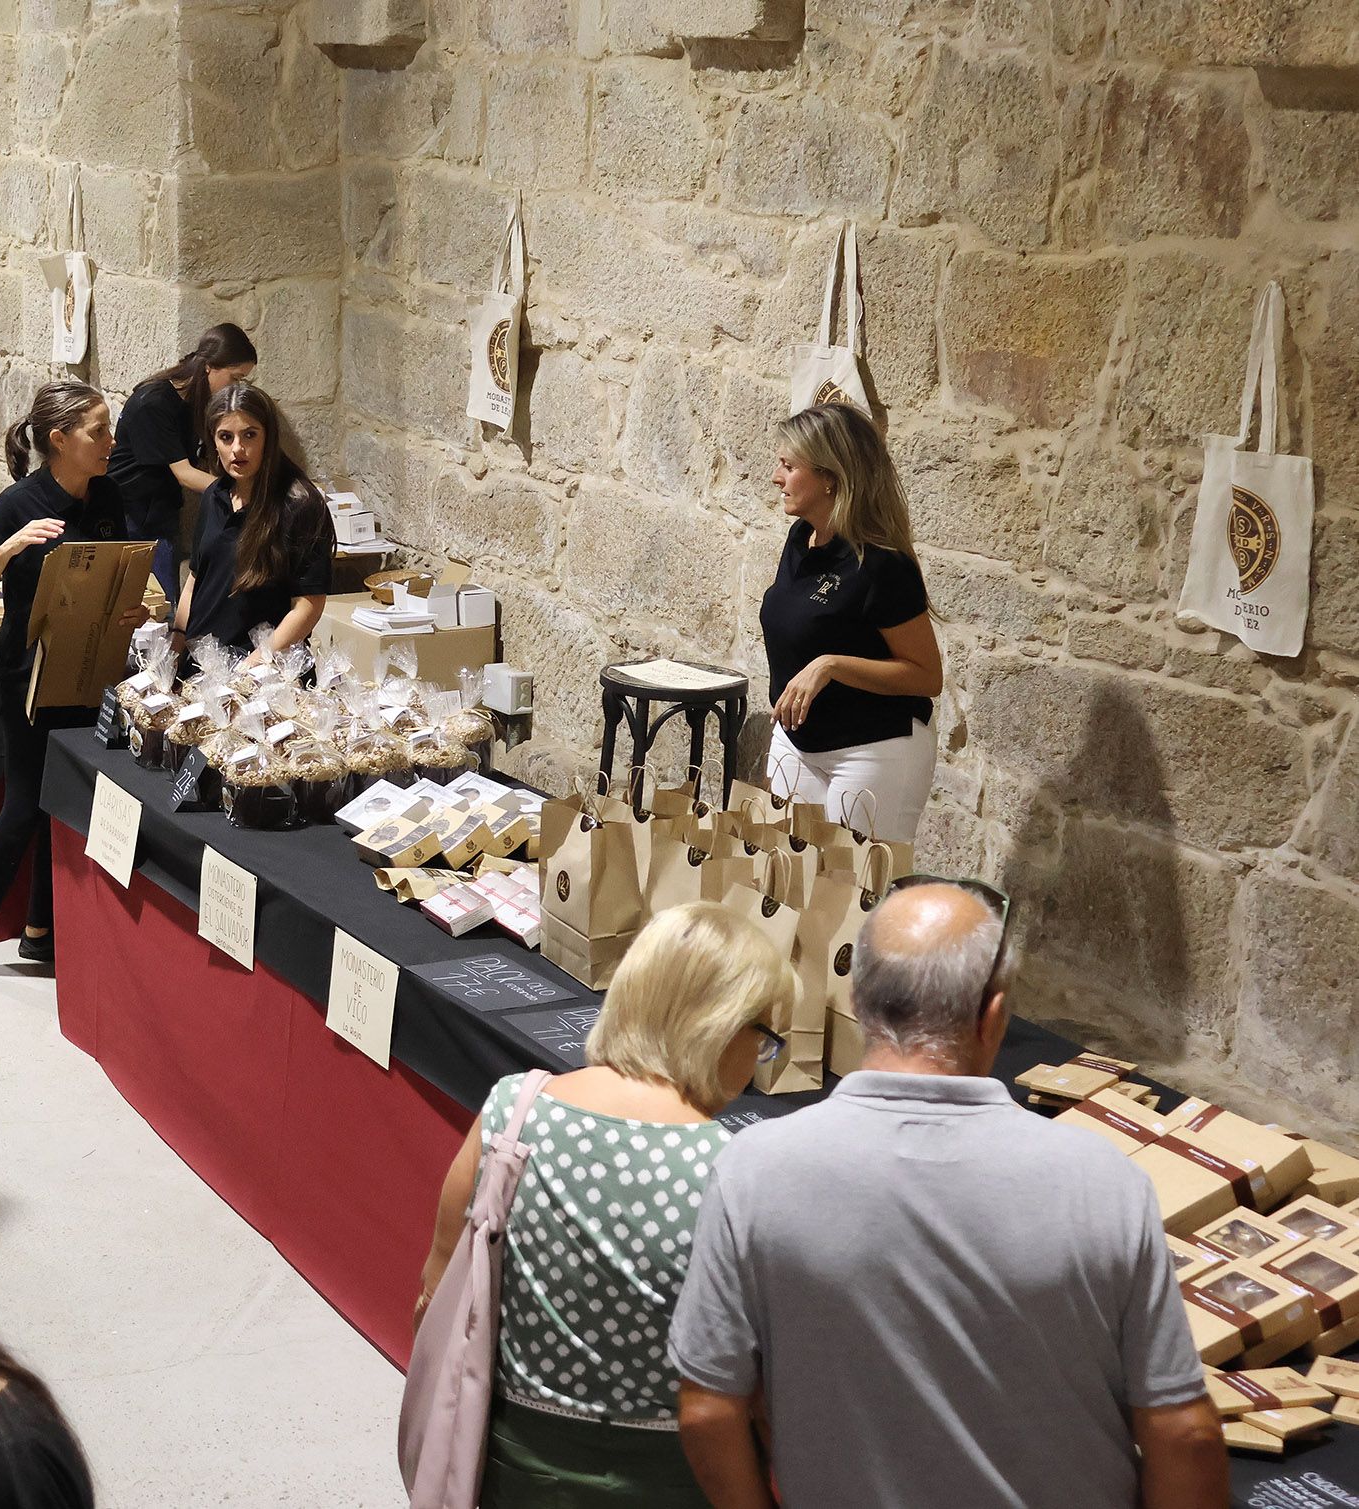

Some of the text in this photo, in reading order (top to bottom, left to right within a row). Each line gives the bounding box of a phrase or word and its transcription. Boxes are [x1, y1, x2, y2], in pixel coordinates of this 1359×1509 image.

[175, 768, 196, 796] 22€
[215, 909, 250, 950] SALVADOR
[340, 948, 386, 992] MONASTERIO
[466, 957, 530, 984] PACK
[353, 981, 362, 998] DE
[433, 972, 500, 998] 17€
[346, 993, 368, 1025] VICO
[563, 1008, 600, 1031] PAC
